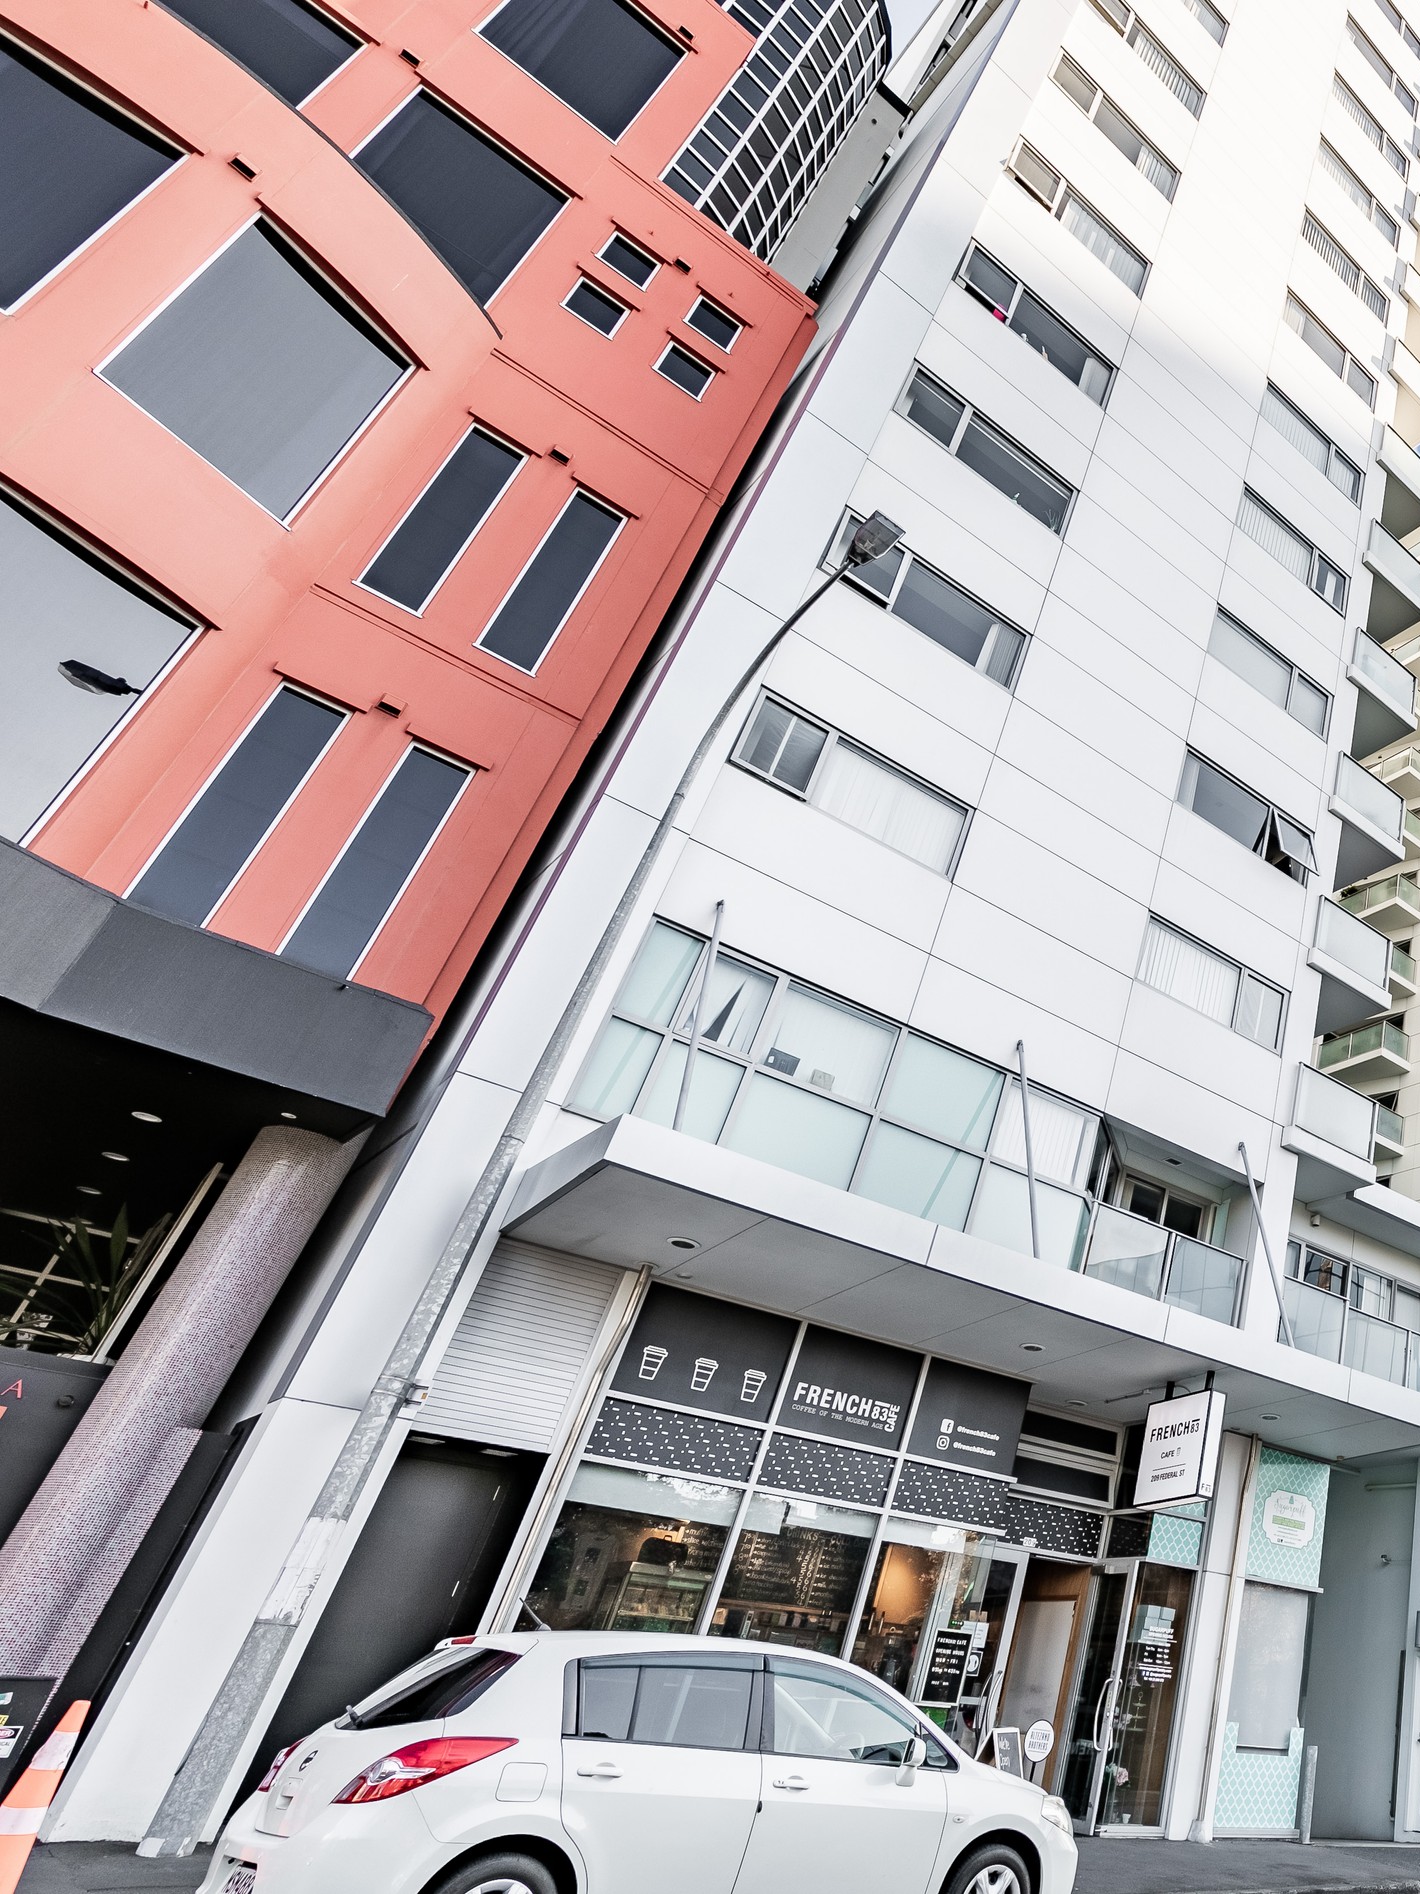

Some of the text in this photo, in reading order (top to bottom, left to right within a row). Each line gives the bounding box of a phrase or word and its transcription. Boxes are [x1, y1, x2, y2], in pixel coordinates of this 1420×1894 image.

[792, 1403, 817, 1414] COFFEE
[831, 1412, 843, 1421] THE
[845, 1416, 869, 1426] MODERN
[871, 1422, 883, 1430] AGE
[884, 1404, 900, 1432] CAFE
[1161, 1450, 1175, 1459] CAFE
[1160, 1471, 1178, 1481] FEDERAL
[1179, 1469, 1186, 1477] ST
